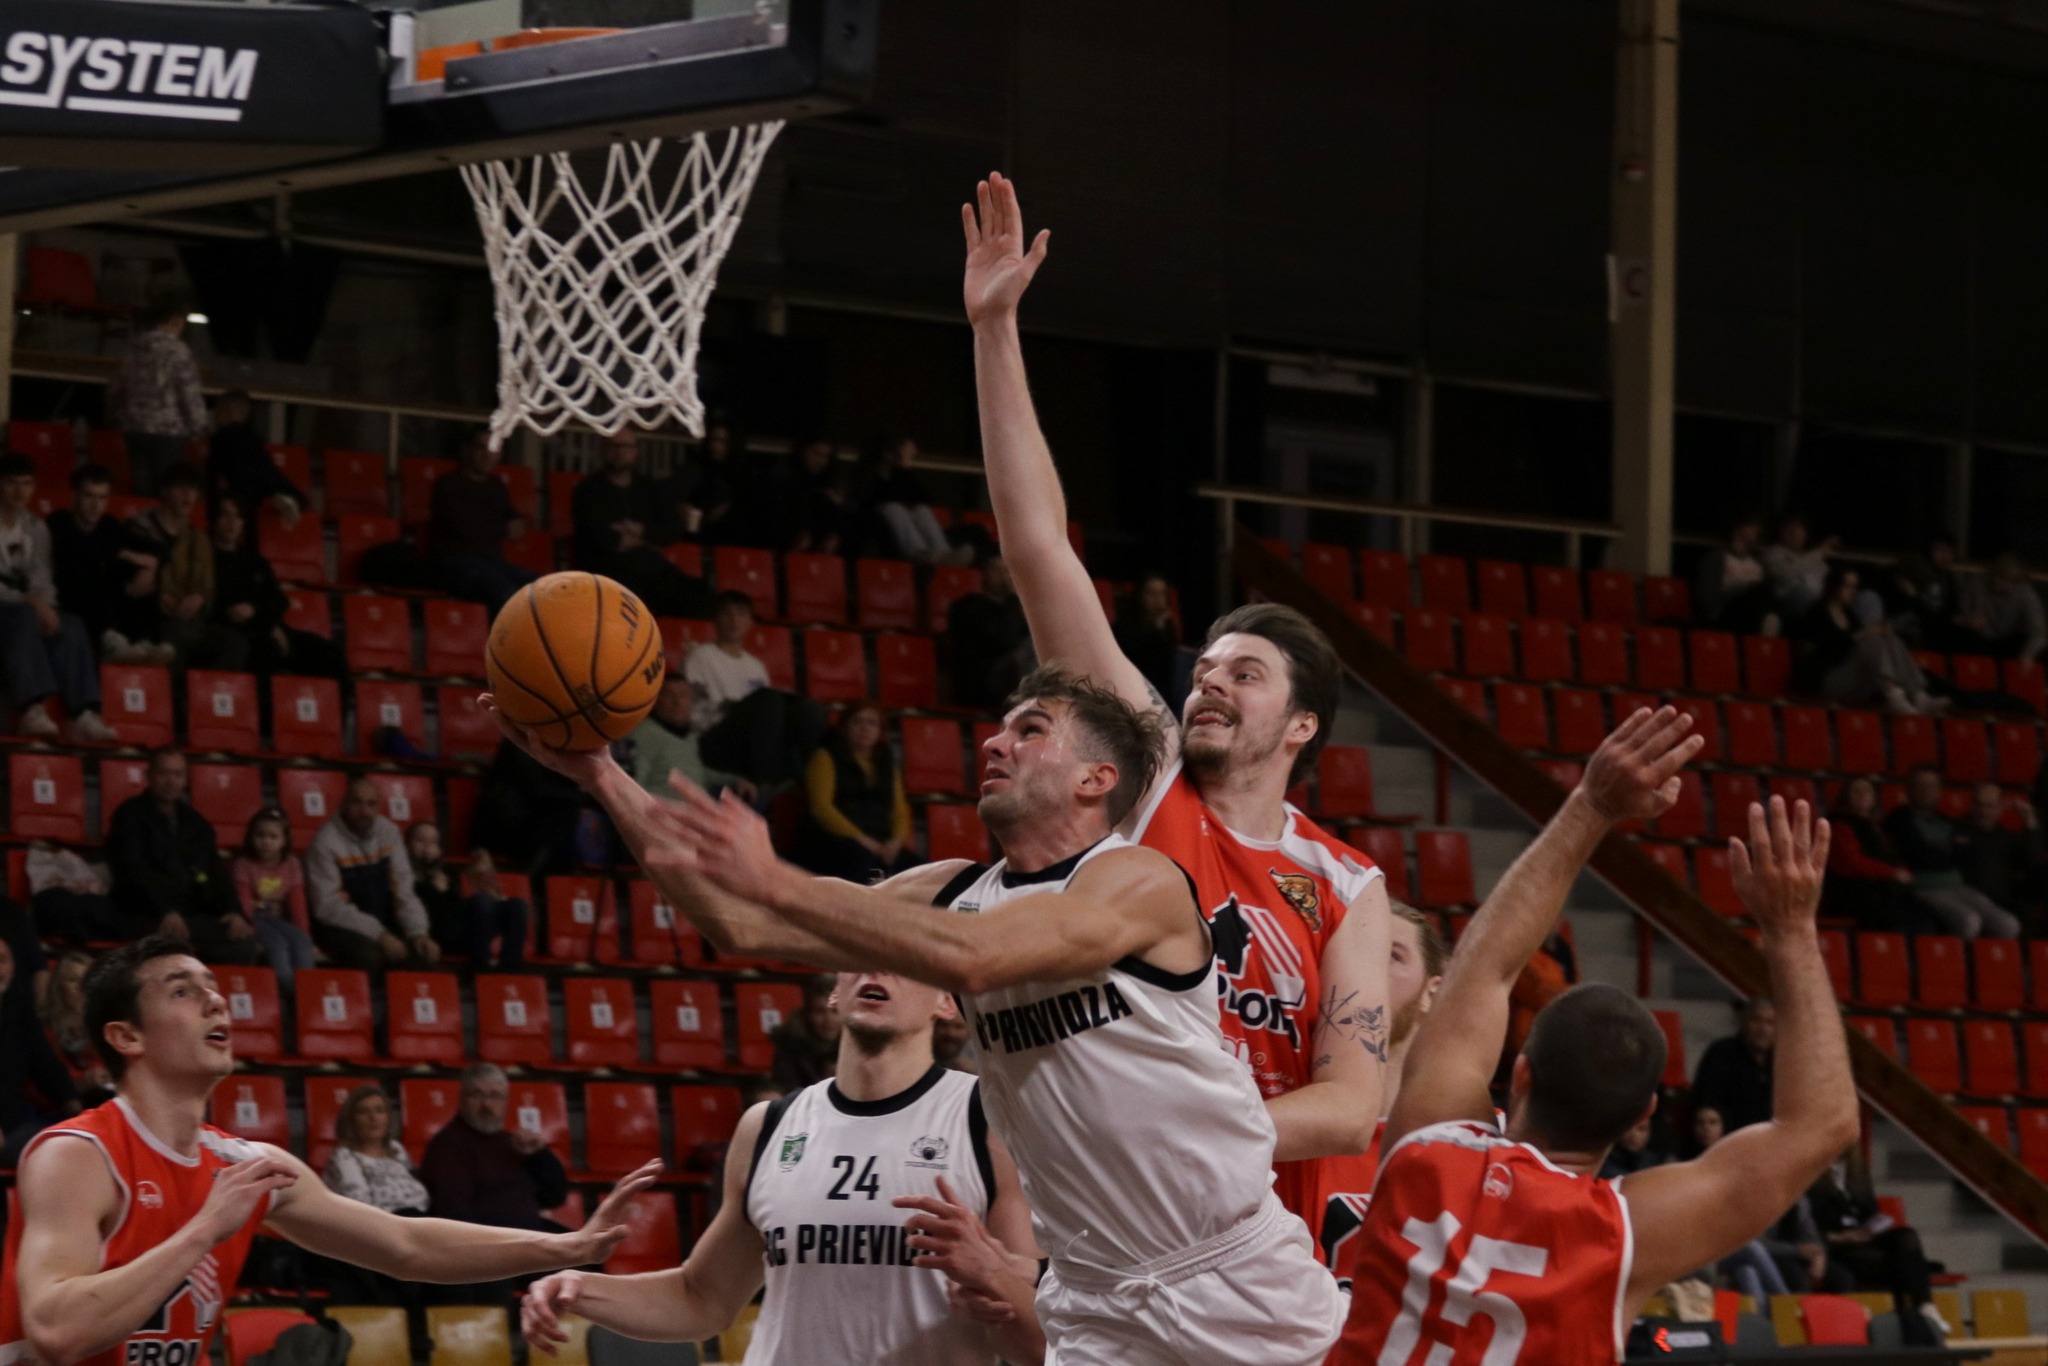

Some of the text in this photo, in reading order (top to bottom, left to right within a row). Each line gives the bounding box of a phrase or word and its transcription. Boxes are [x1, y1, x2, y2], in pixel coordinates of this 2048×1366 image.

[0, 30, 260, 108] SYSTEM
[826, 1155, 879, 1201] 24
[1376, 1209, 1549, 1366] 15
